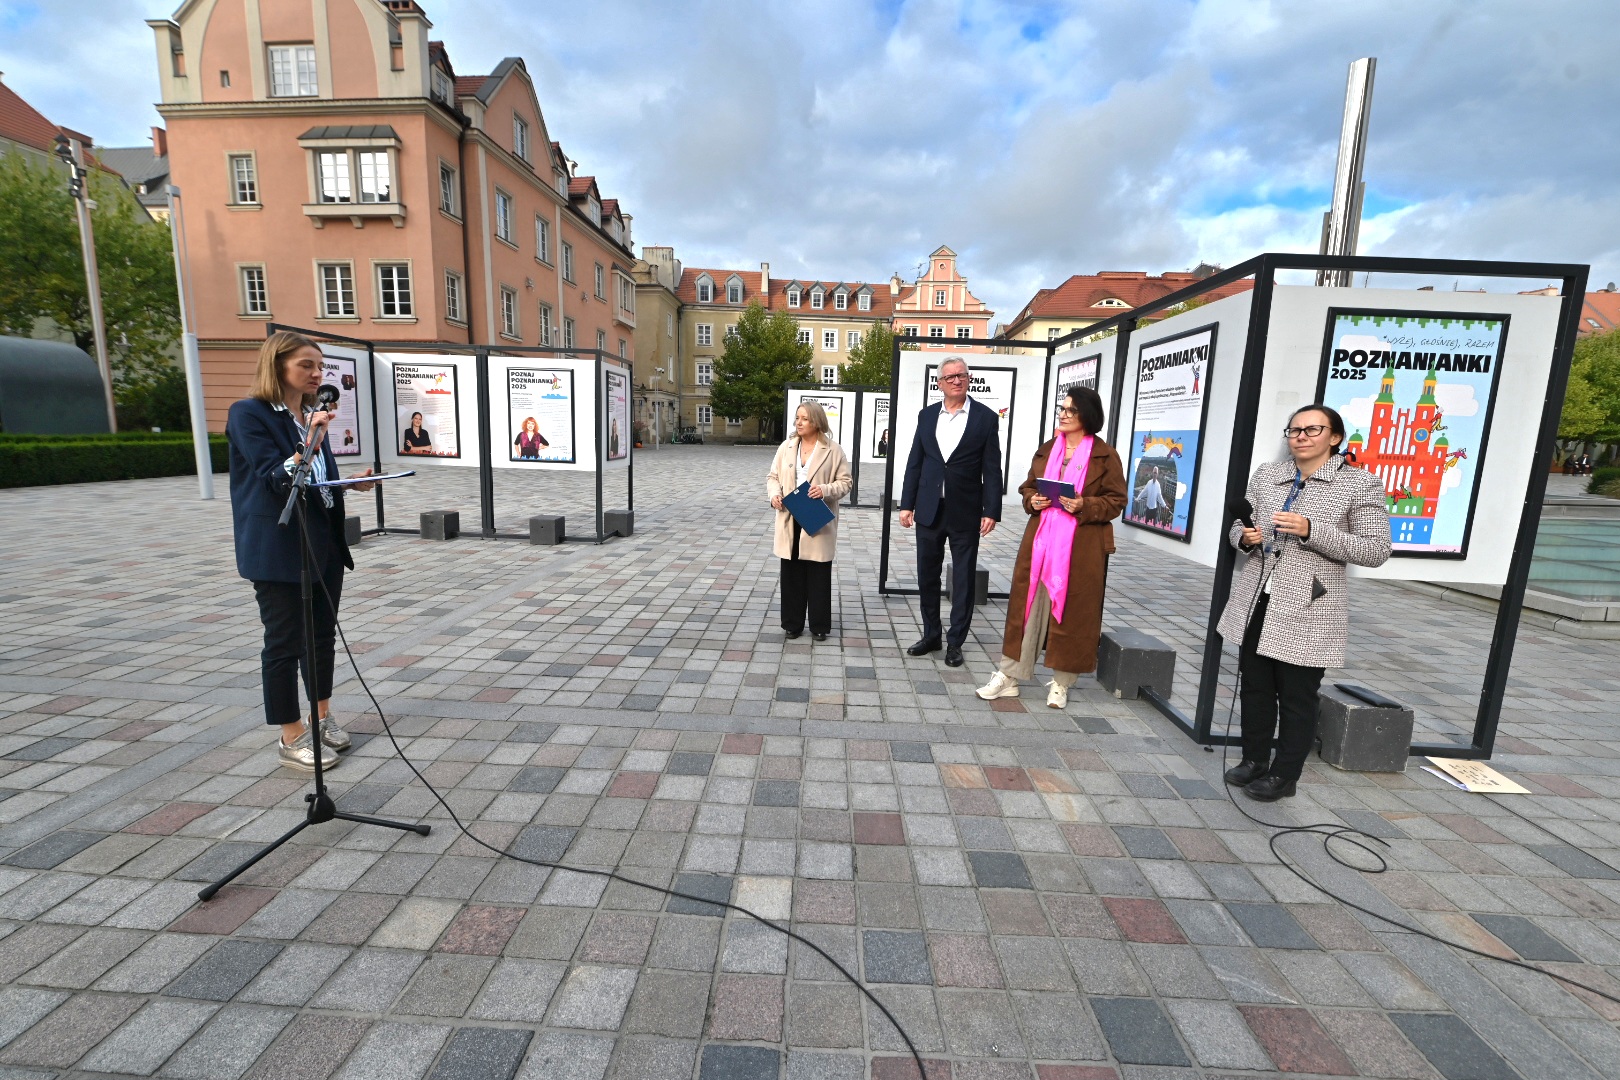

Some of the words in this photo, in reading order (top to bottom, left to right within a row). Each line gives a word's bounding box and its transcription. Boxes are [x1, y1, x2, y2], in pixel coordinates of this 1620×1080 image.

[1332, 349, 1492, 373] POZNANIANKI
[1140, 372, 1154, 382] 2025
[1330, 368, 1367, 380] 2025
